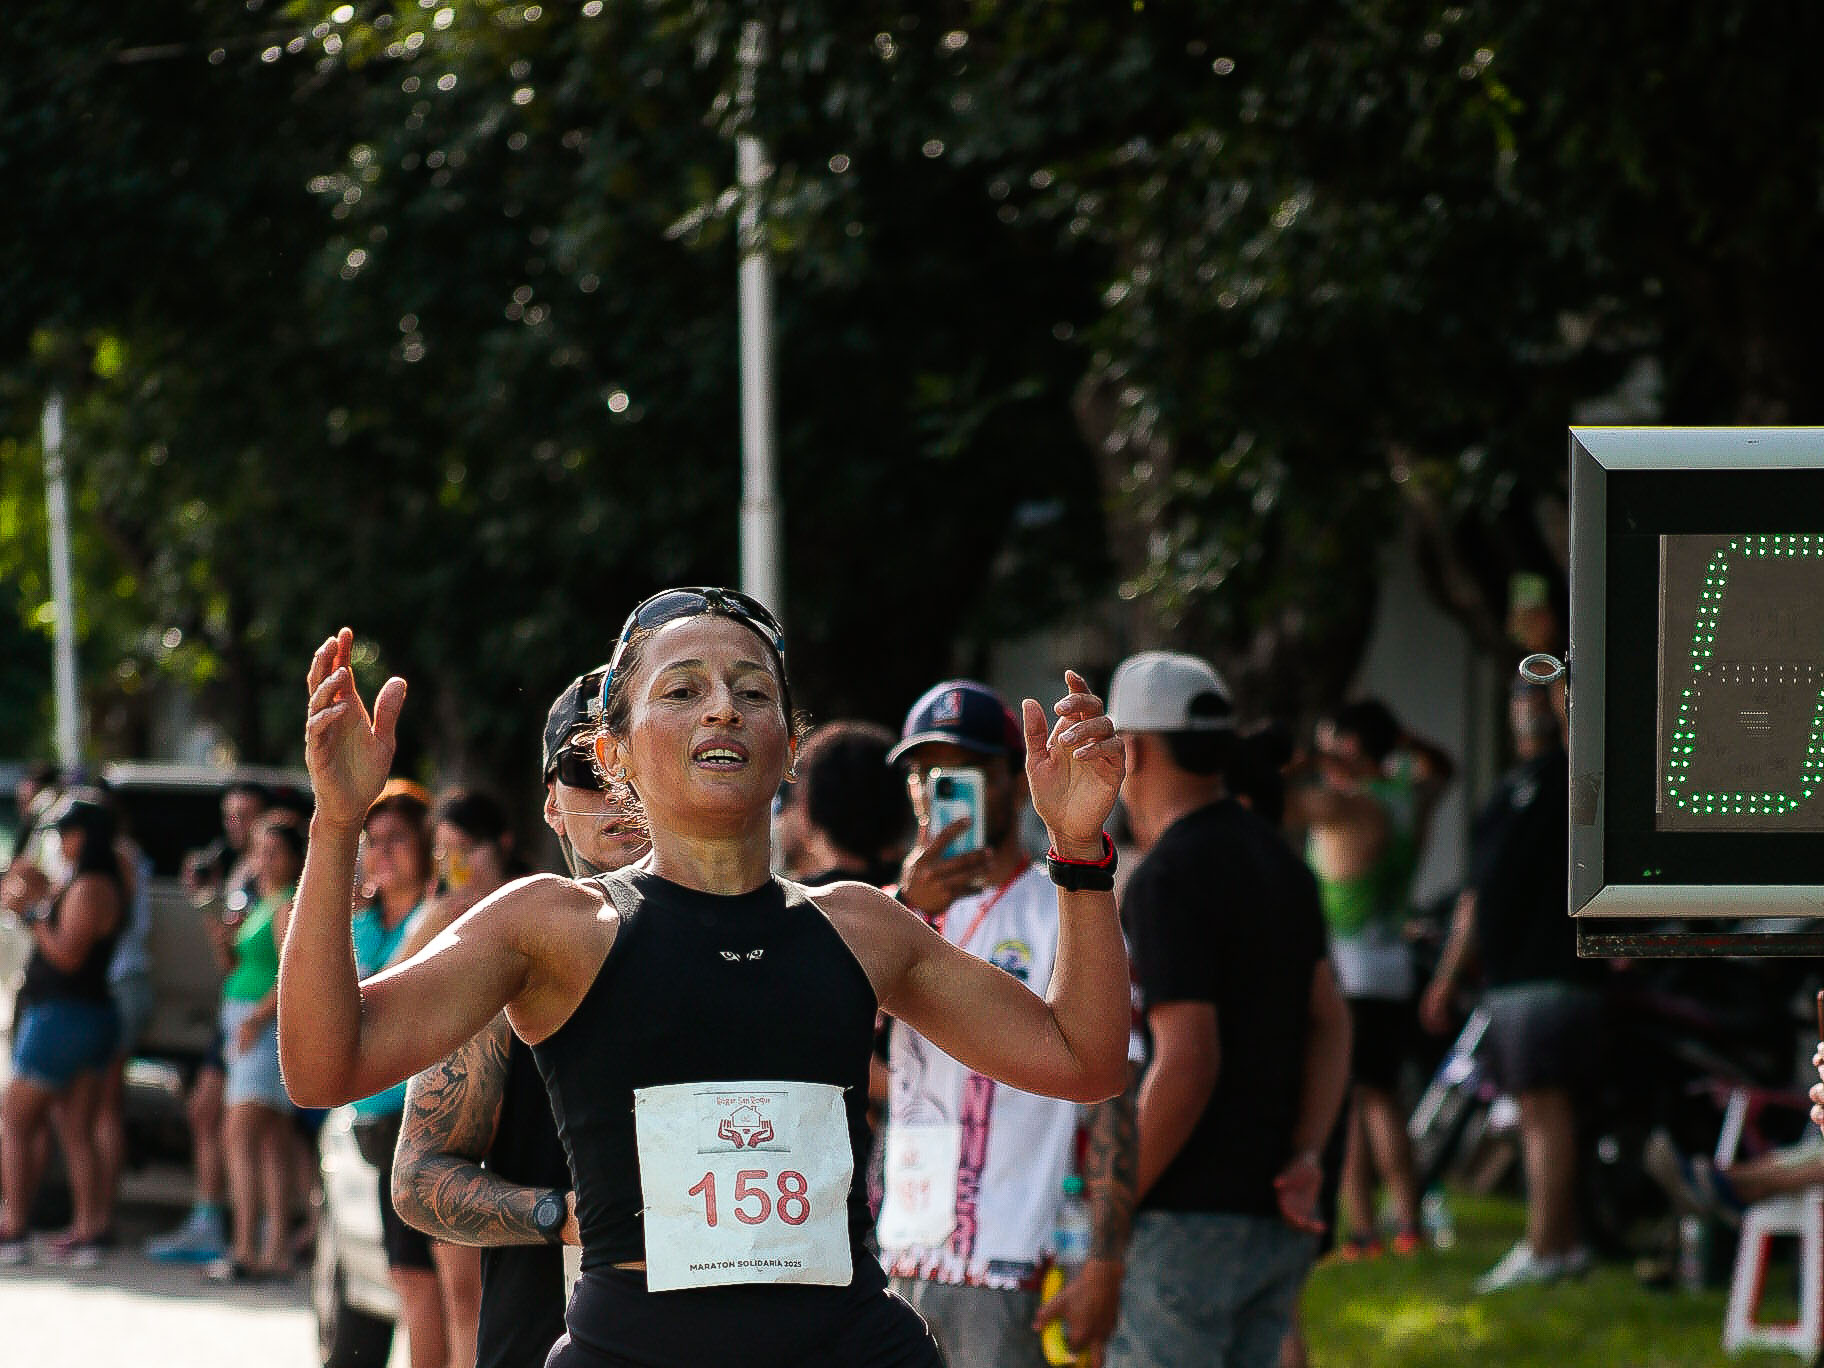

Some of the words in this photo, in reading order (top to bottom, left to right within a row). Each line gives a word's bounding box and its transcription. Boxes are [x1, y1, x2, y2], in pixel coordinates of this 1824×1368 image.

[687, 1170, 811, 1227] 158
[689, 1260, 735, 1272] MARATON
[737, 1259, 783, 1268] SOLIDARIA
[783, 1260, 802, 1268] 2025
